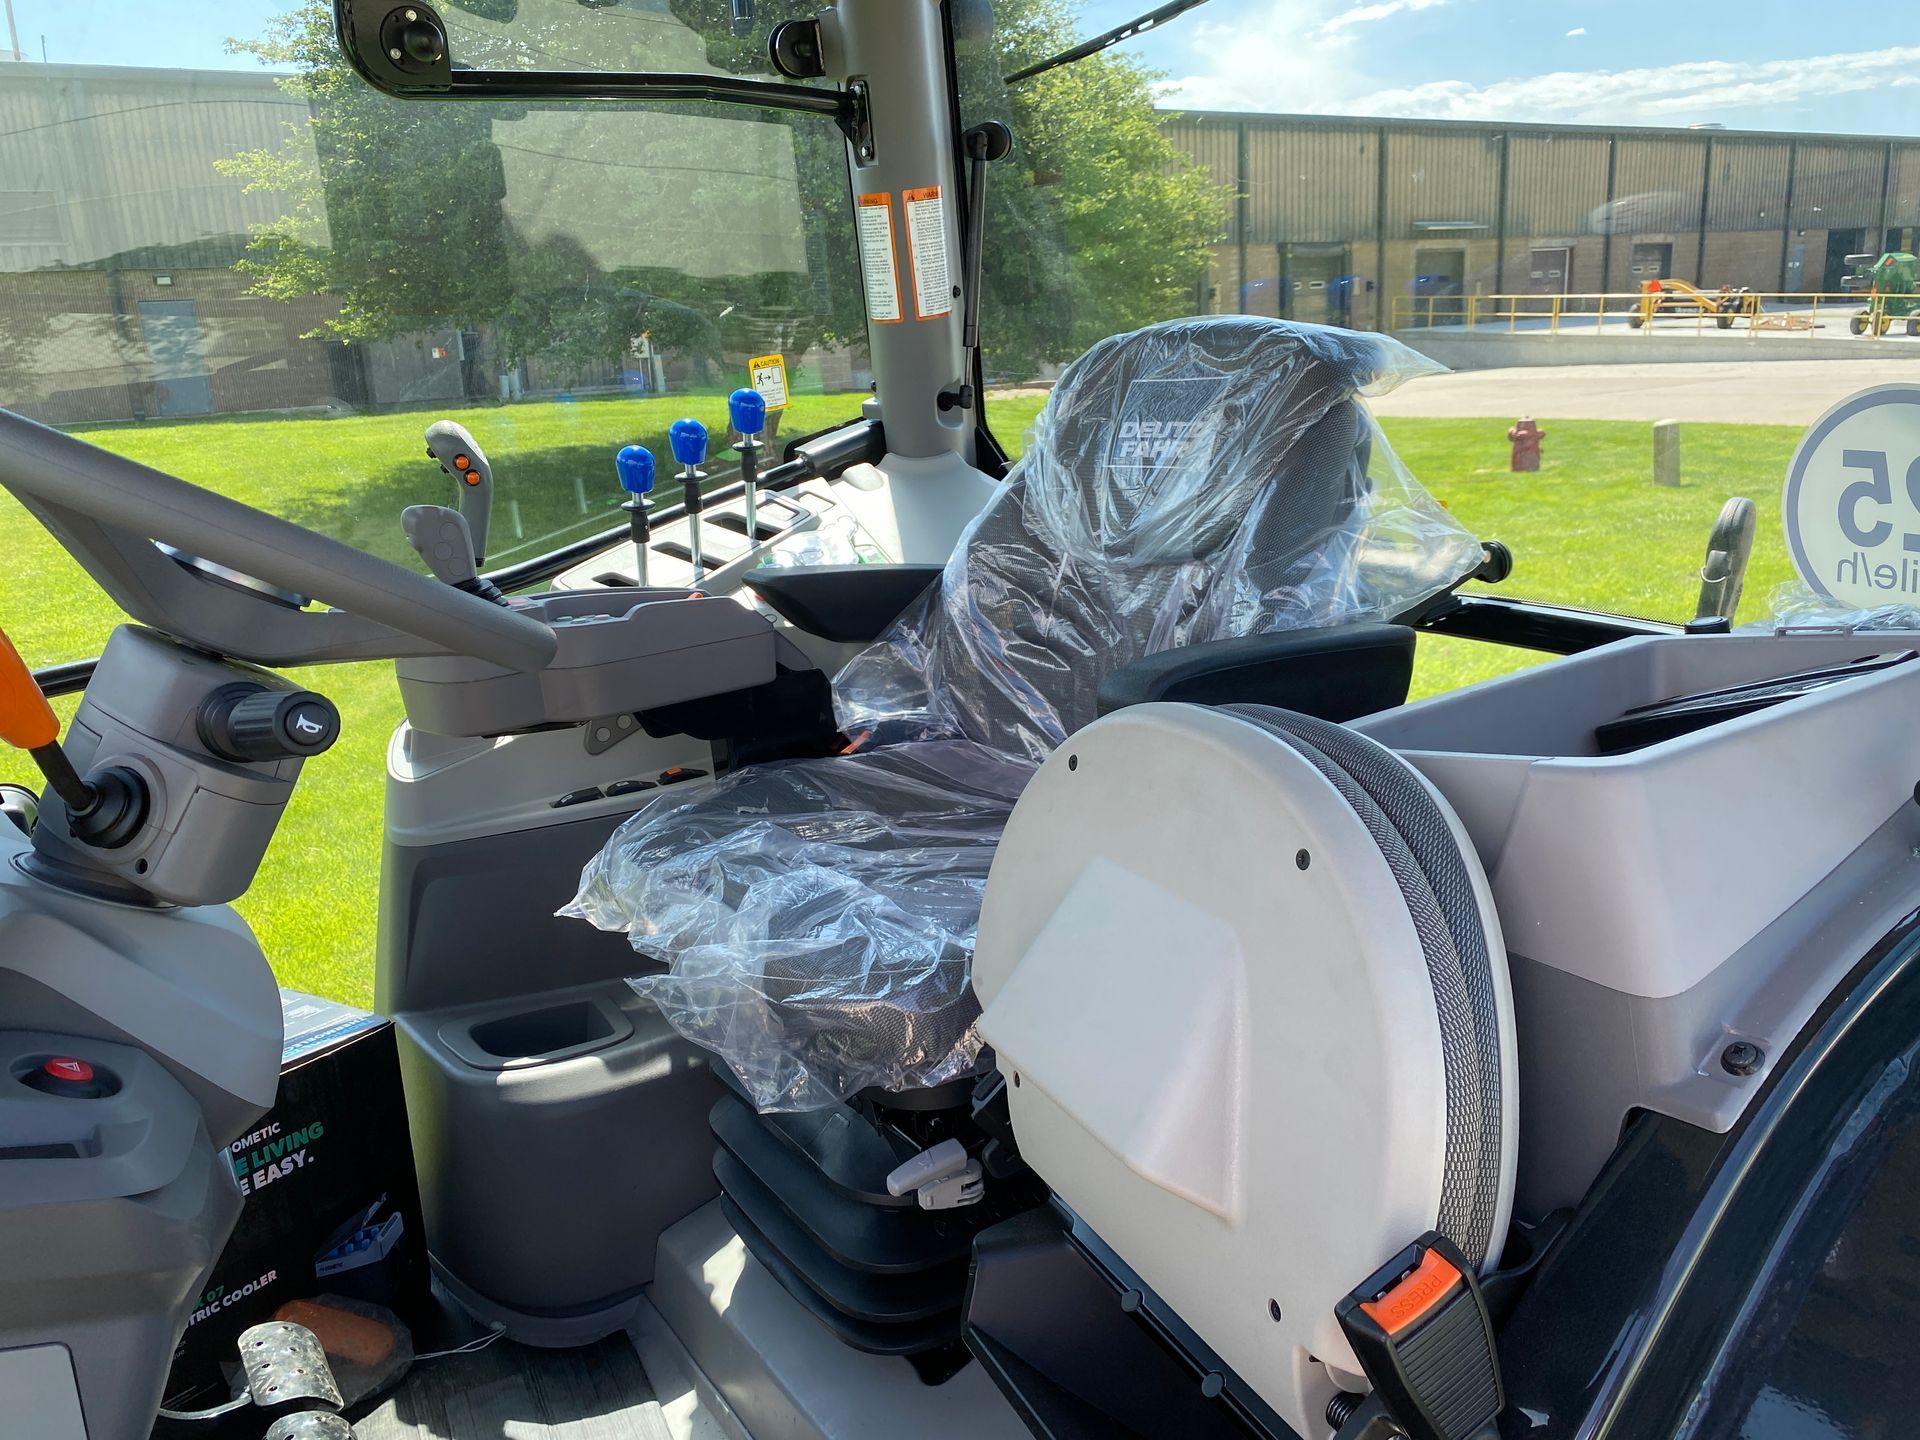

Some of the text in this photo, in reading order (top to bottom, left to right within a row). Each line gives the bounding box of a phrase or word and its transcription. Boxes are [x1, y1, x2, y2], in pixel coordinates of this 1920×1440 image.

[251, 1121, 324, 1169] LIVING
[252, 1148, 314, 1190] EASY.
[206, 1285, 225, 1302] 07
[222, 1269, 278, 1307] COOLER
[1390, 1275, 1443, 1319] PRESS
